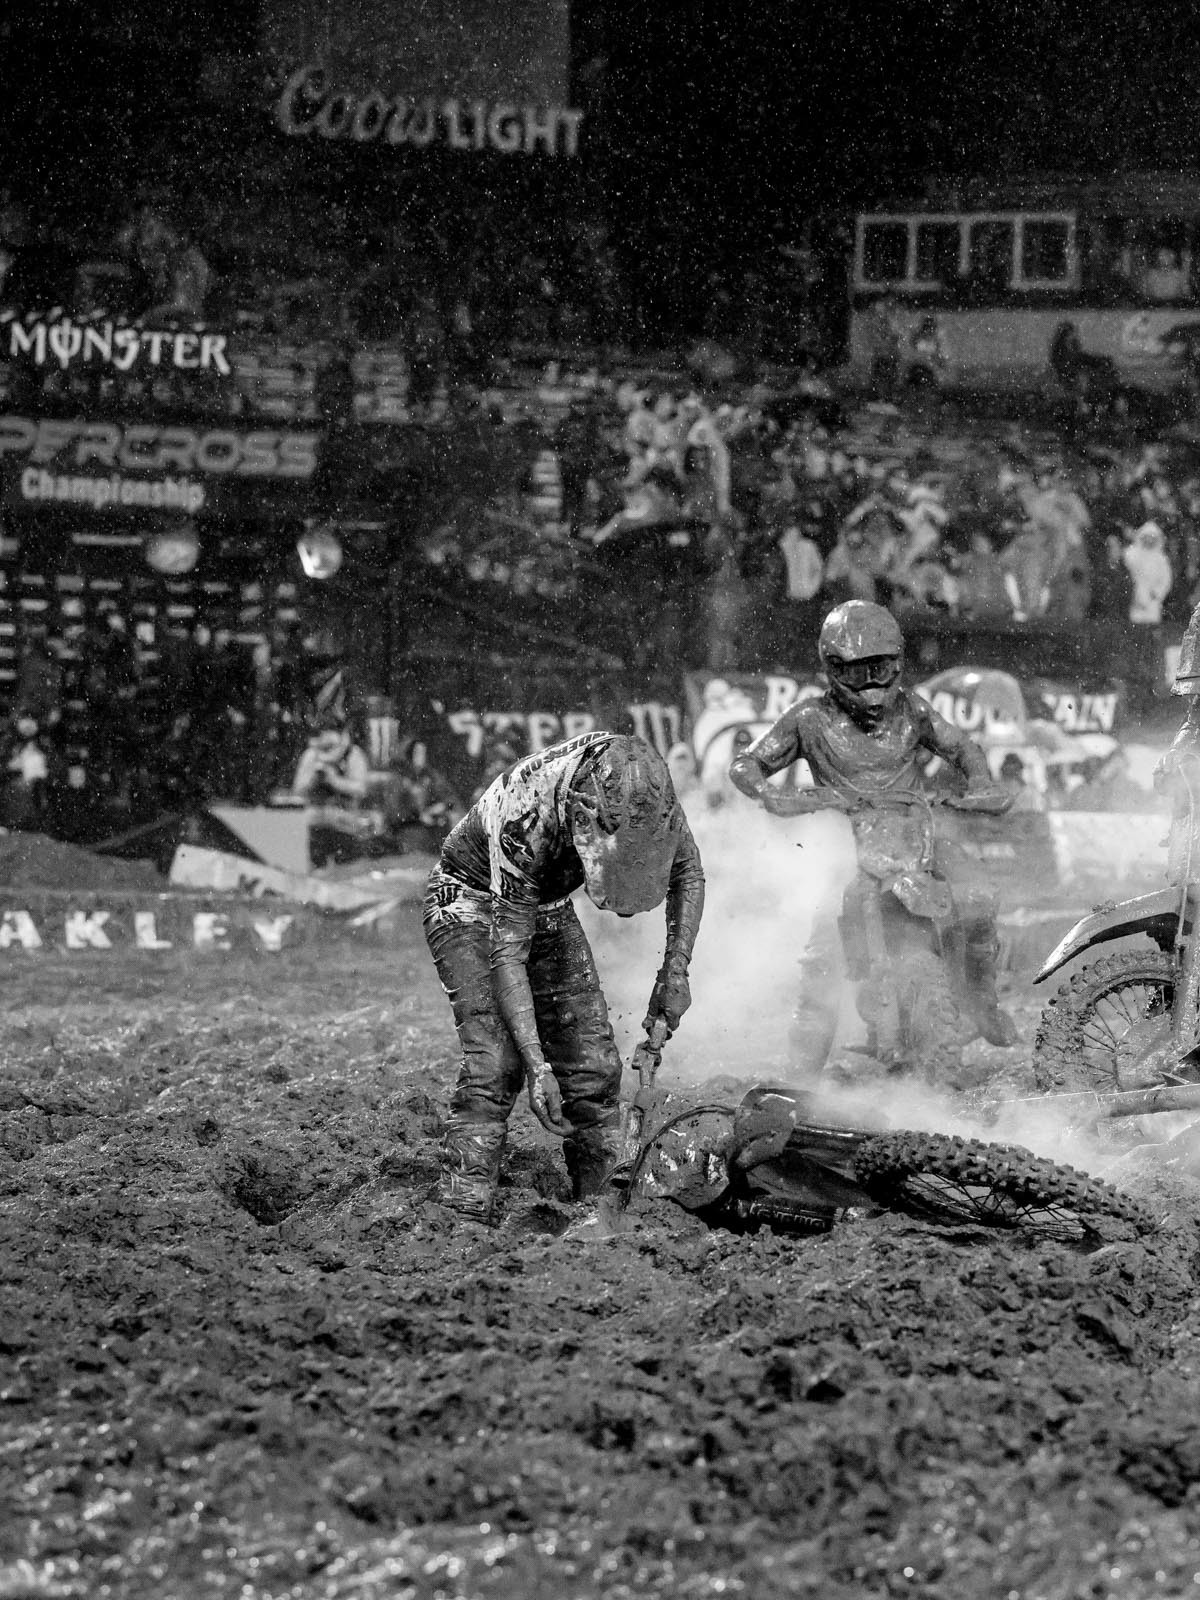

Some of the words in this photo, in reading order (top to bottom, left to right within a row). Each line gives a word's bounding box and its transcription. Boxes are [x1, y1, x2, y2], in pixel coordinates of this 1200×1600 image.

[444, 100, 585, 156] LIGHT
[9, 318, 231, 376] MONSTER
[20, 466, 205, 513] Championship
[0, 910, 293, 952] AKLEY
